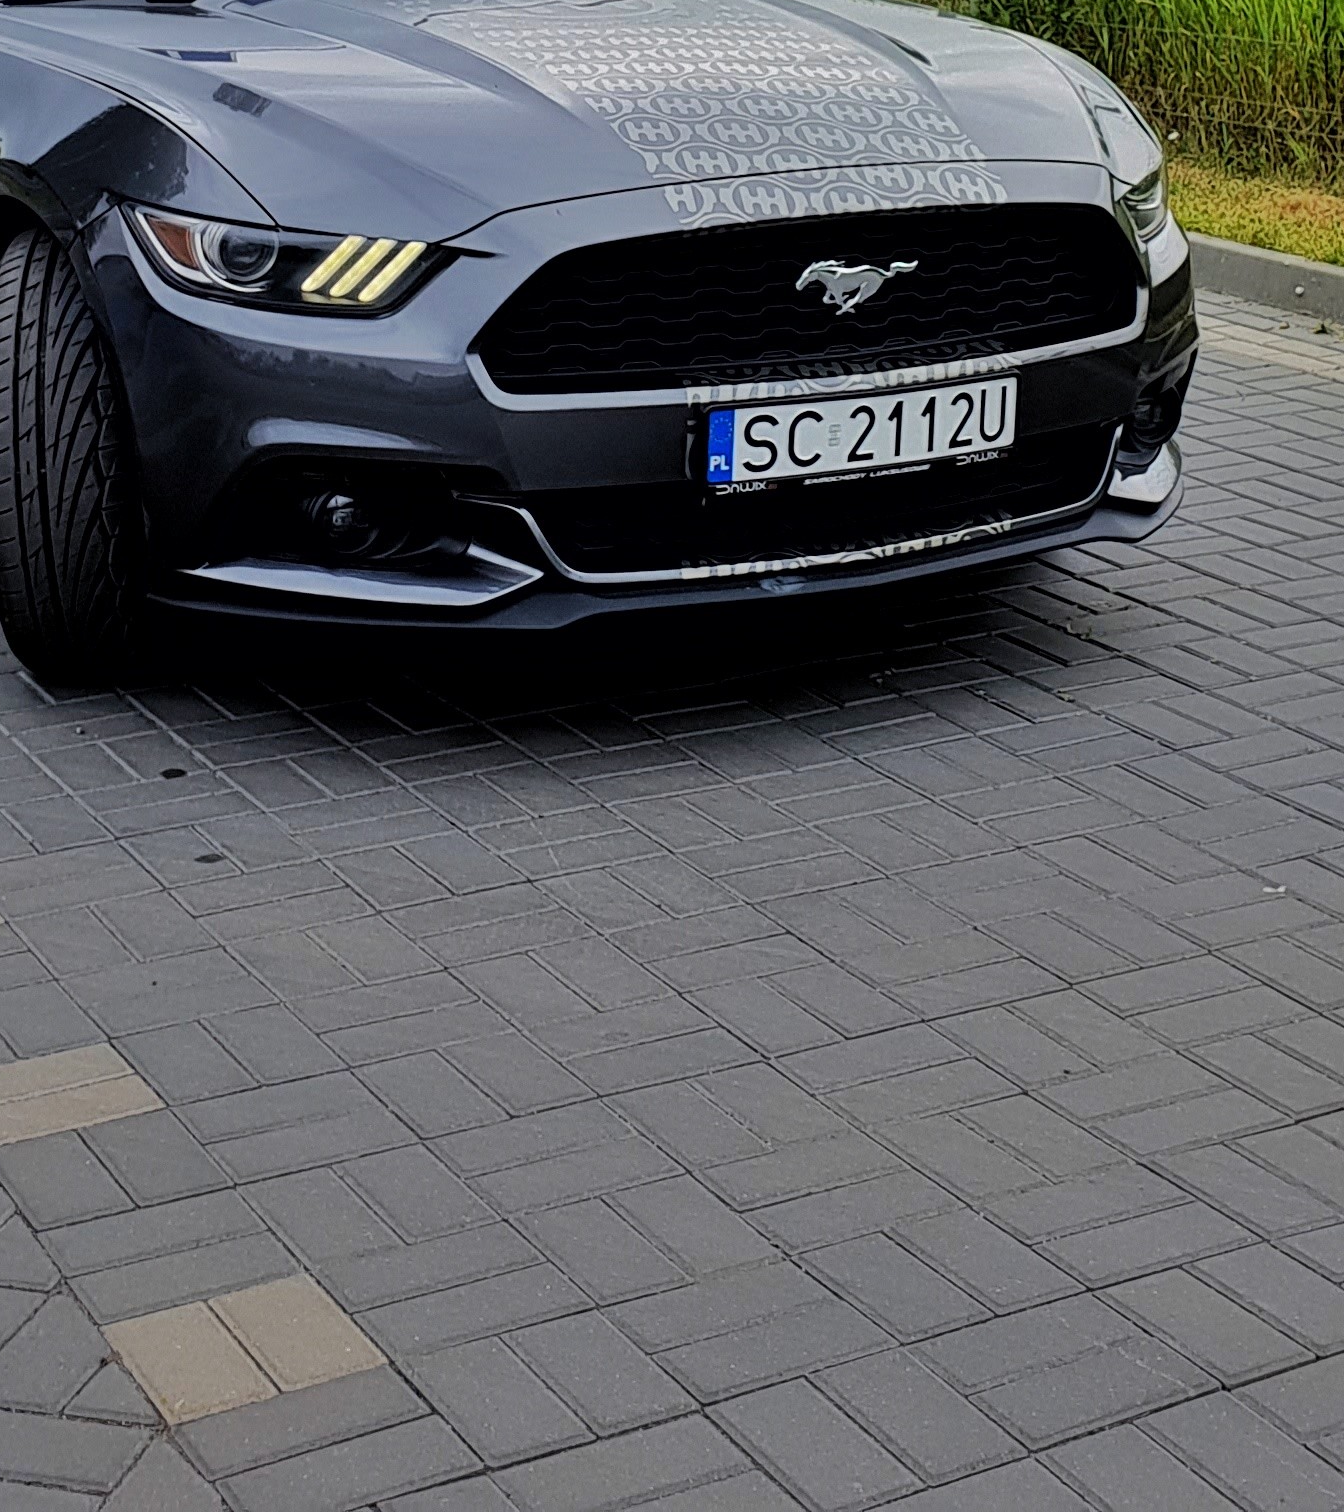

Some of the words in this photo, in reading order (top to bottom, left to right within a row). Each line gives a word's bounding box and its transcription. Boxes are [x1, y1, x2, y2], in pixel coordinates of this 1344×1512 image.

[742, 410, 824, 473] SC
[847, 385, 1008, 463] 2112U
[709, 454, 730, 472] PL
